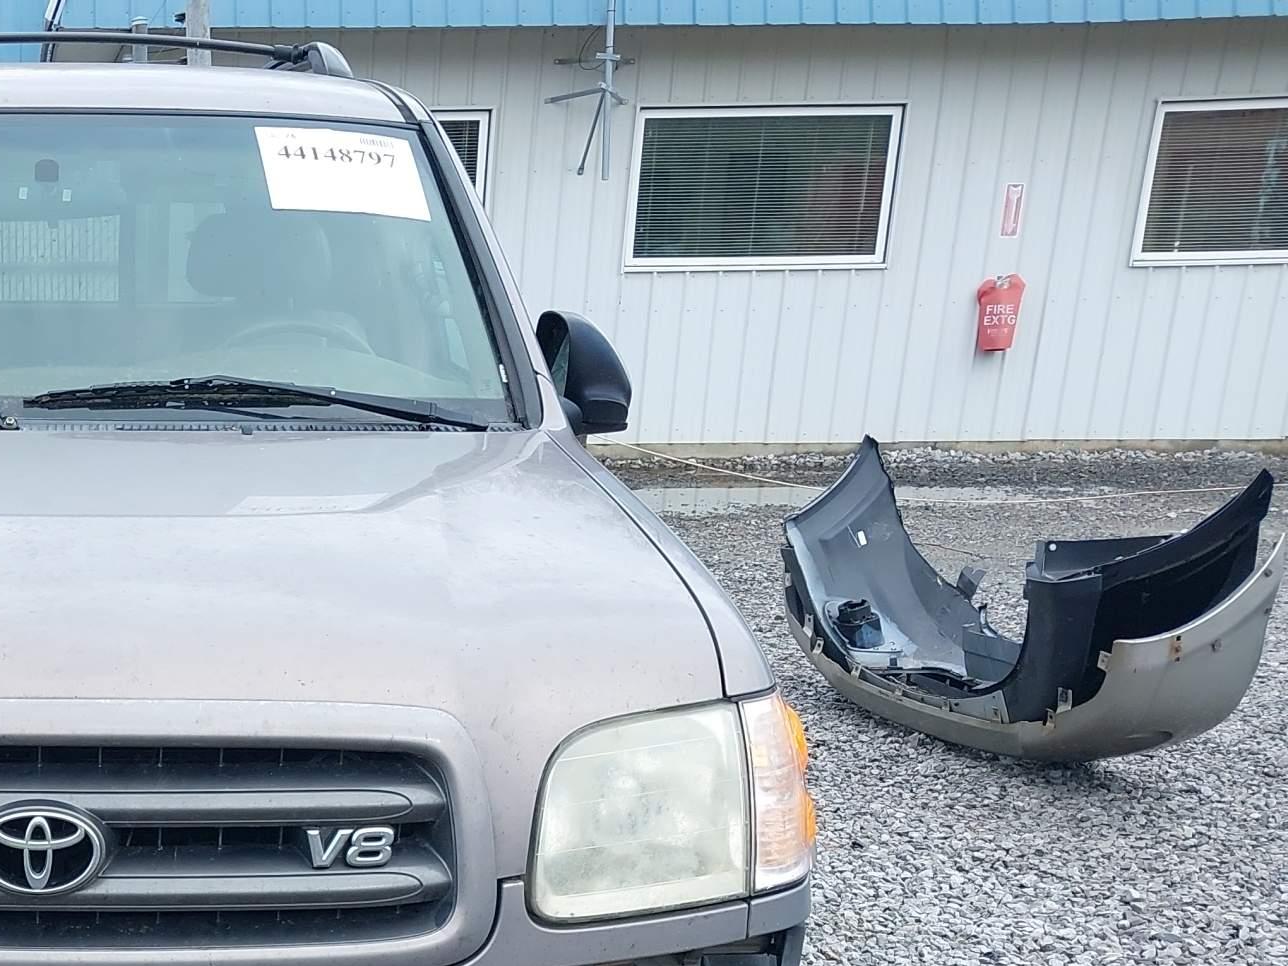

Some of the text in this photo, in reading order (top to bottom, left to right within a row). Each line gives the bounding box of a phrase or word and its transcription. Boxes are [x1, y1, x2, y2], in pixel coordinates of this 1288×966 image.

[277, 145, 395, 168] 44148797
[986, 304, 1015, 315] FIRE
[983, 315, 1017, 326] EXTG
[306, 826, 395, 868] V8
